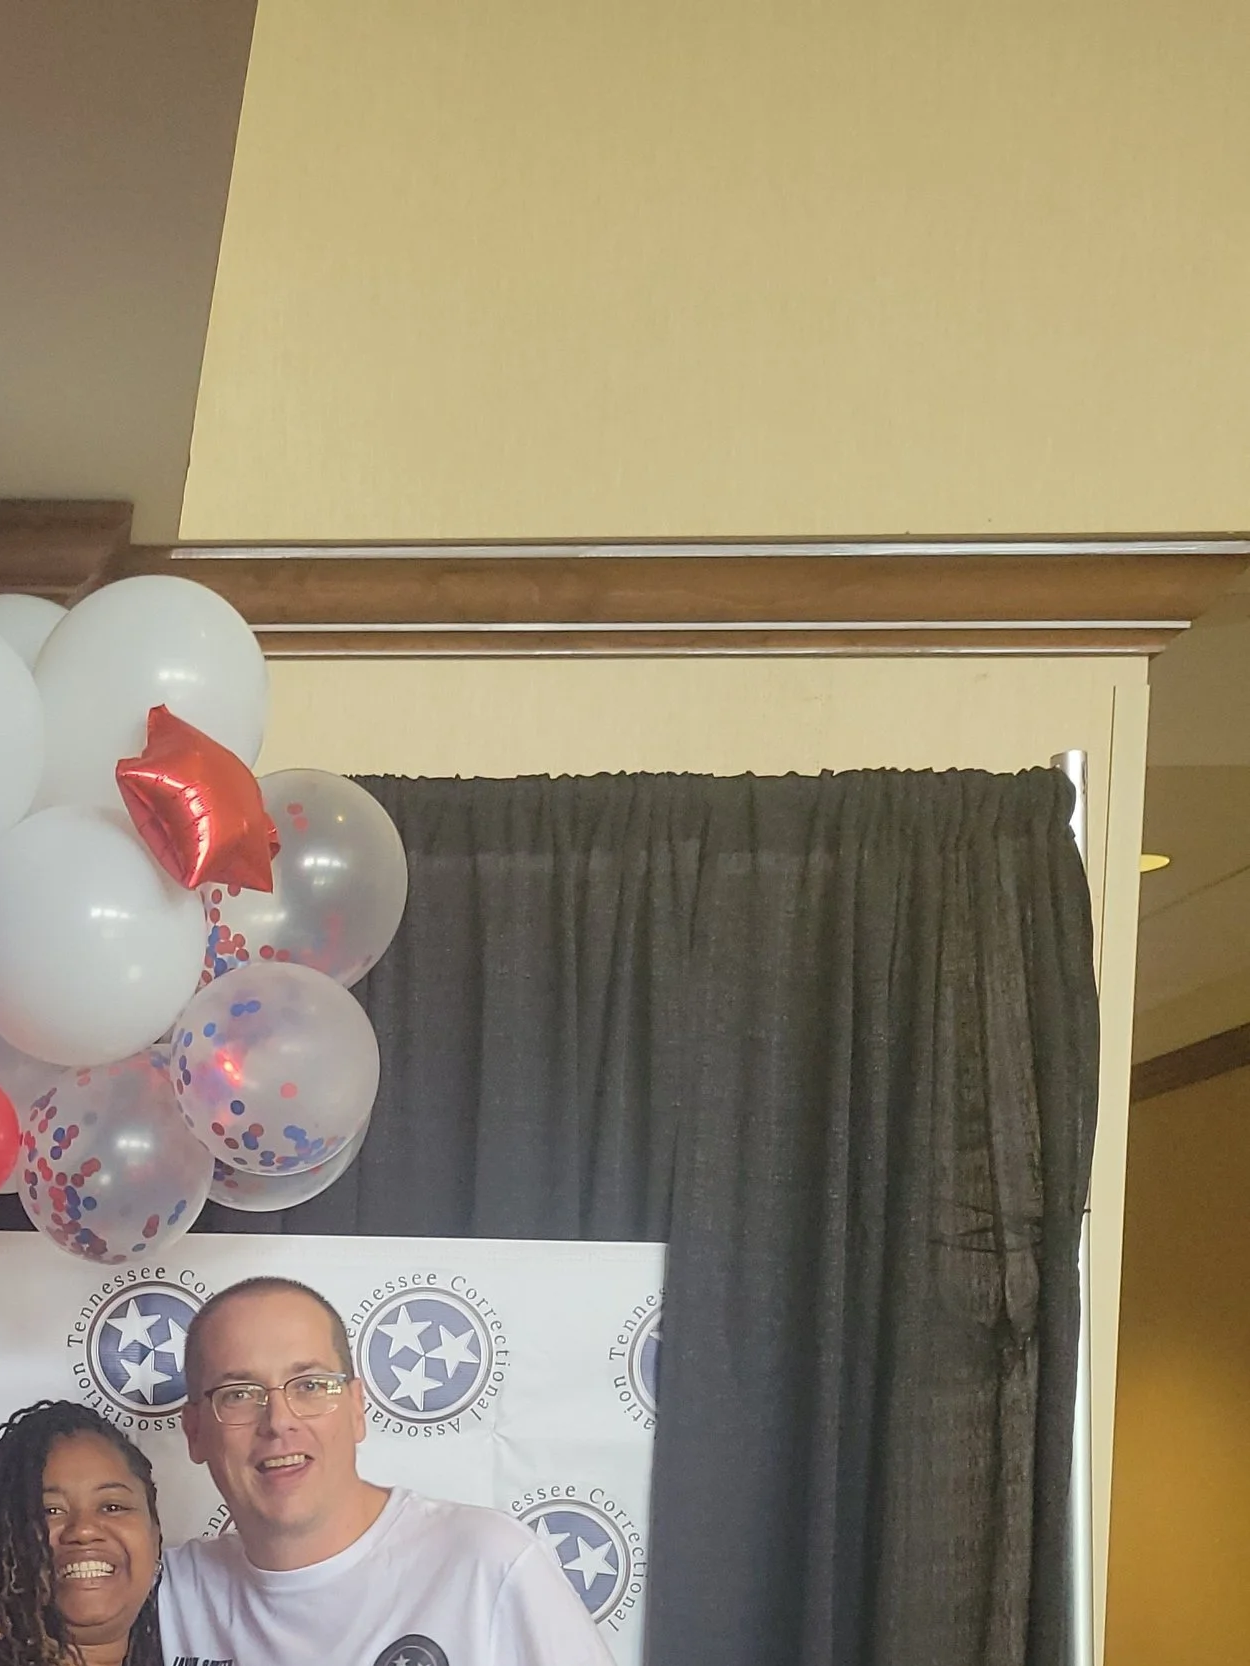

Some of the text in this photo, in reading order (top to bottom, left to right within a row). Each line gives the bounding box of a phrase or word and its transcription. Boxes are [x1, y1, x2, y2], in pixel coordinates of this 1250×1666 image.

[67, 1266, 176, 1431] Tennessee ssociation
[346, 1273, 510, 1438] ennessee Correctional Associat
[609, 1291, 661, 1361] Tenne
[511, 1485, 648, 1632] essee Correctional
